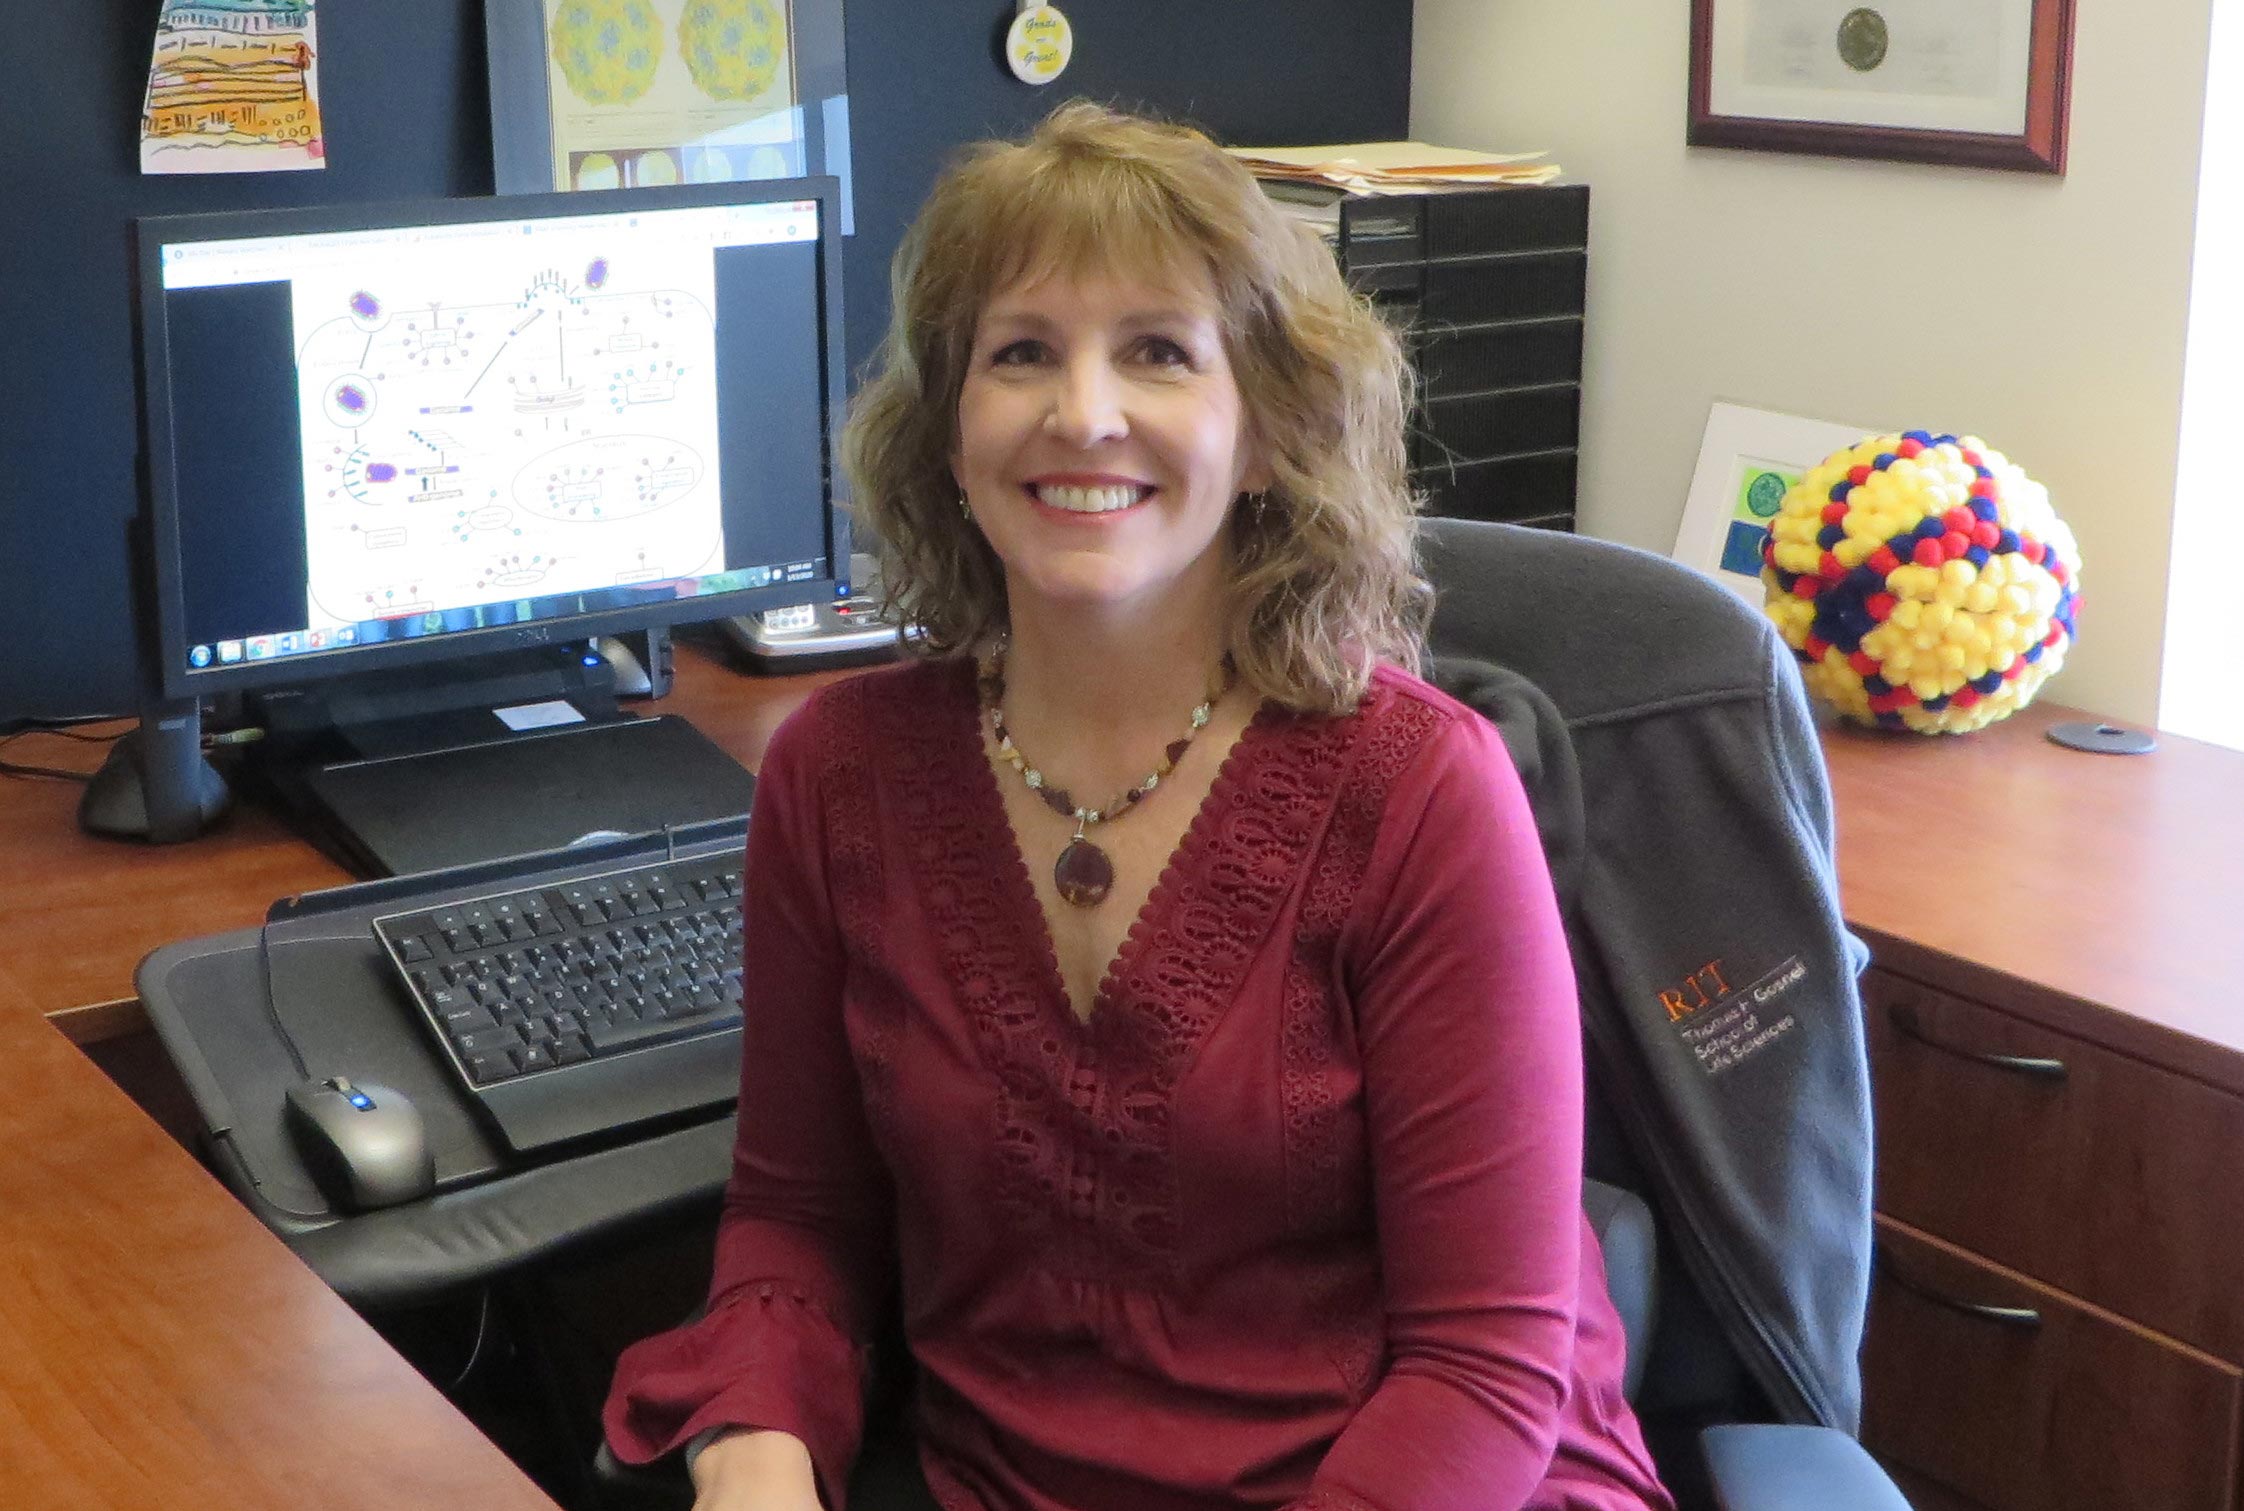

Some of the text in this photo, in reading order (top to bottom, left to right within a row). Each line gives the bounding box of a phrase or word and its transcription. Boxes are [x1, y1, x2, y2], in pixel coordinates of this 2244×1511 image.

[1657, 958, 1730, 1023] RIT
[1682, 1007, 1740, 1039] Thomas
[1730, 1014, 1795, 1059] Sciences
[1744, 1012, 1759, 1031] of
